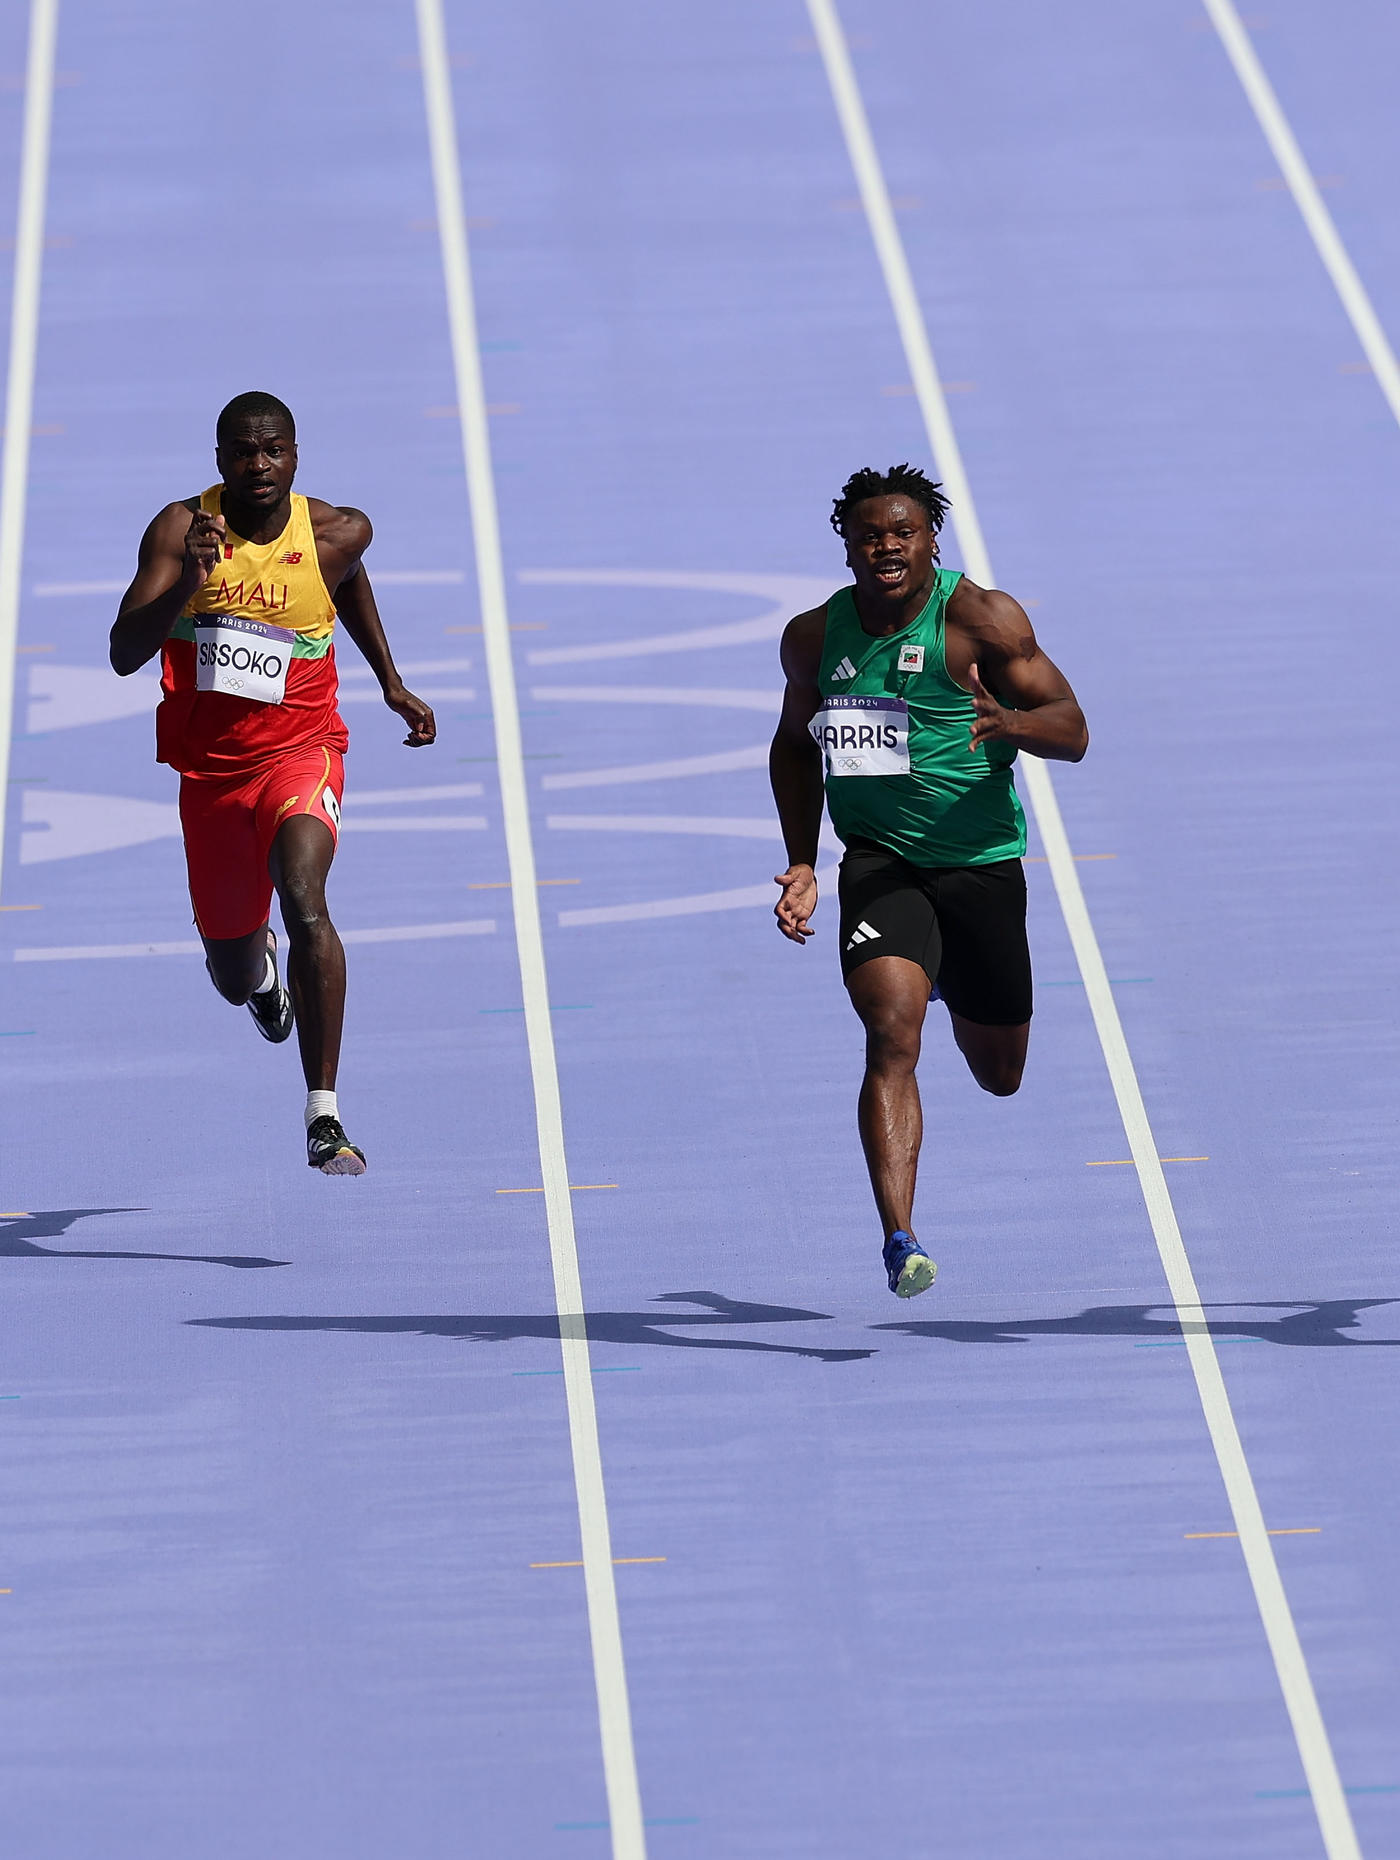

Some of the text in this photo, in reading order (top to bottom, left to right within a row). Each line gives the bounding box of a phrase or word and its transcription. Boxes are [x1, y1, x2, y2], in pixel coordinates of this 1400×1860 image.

[216, 577, 287, 609] MALI
[217, 617, 267, 634] PARIS 2024
[200, 642, 282, 678] SISSOKO
[851, 699, 877, 707] 2024
[813, 725, 898, 749] HARRIS
